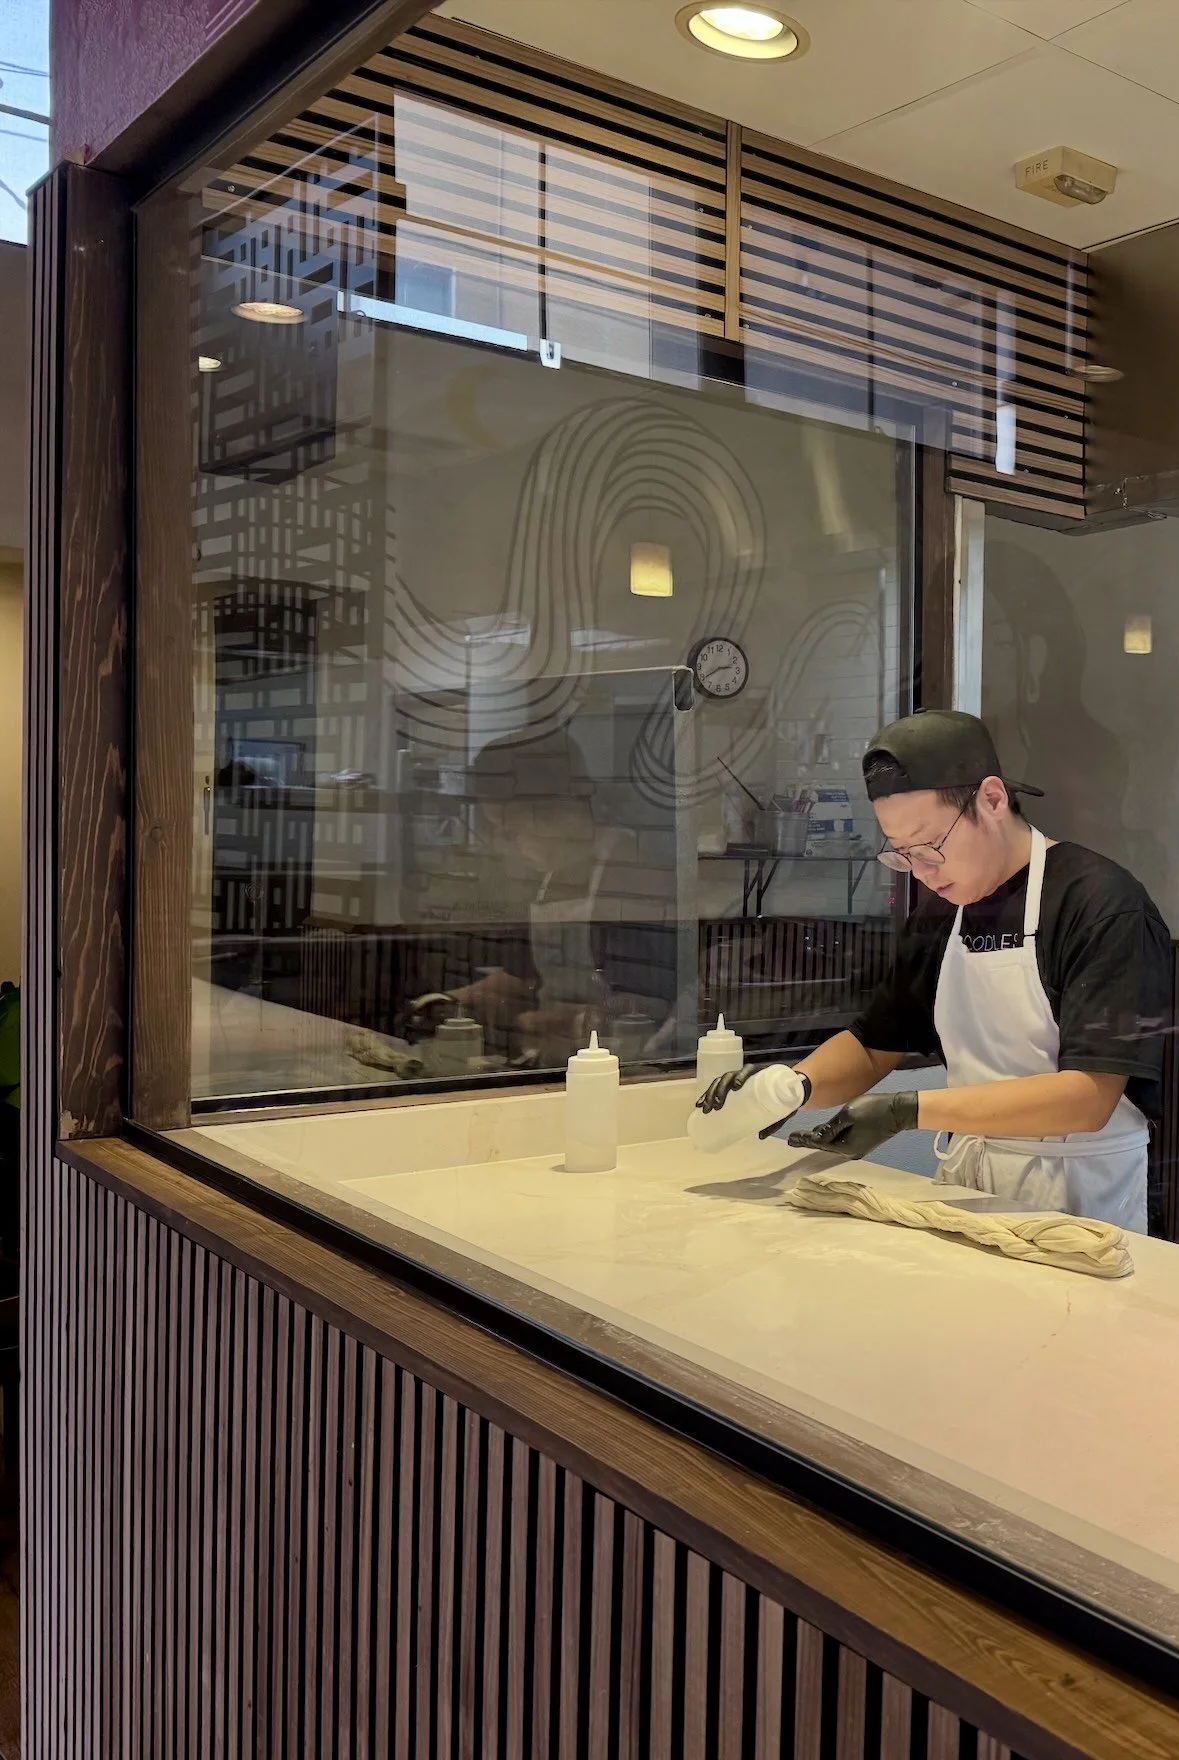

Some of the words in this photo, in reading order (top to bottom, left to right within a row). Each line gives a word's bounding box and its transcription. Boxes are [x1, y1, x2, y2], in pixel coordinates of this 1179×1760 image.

[1025, 160, 1049, 178] FIRE
[707, 646, 714, 654] 11
[716, 644, 724, 652] 12
[700, 653, 708, 661] 10
[732, 656, 738, 664] 2
[707, 681, 713, 689] 7
